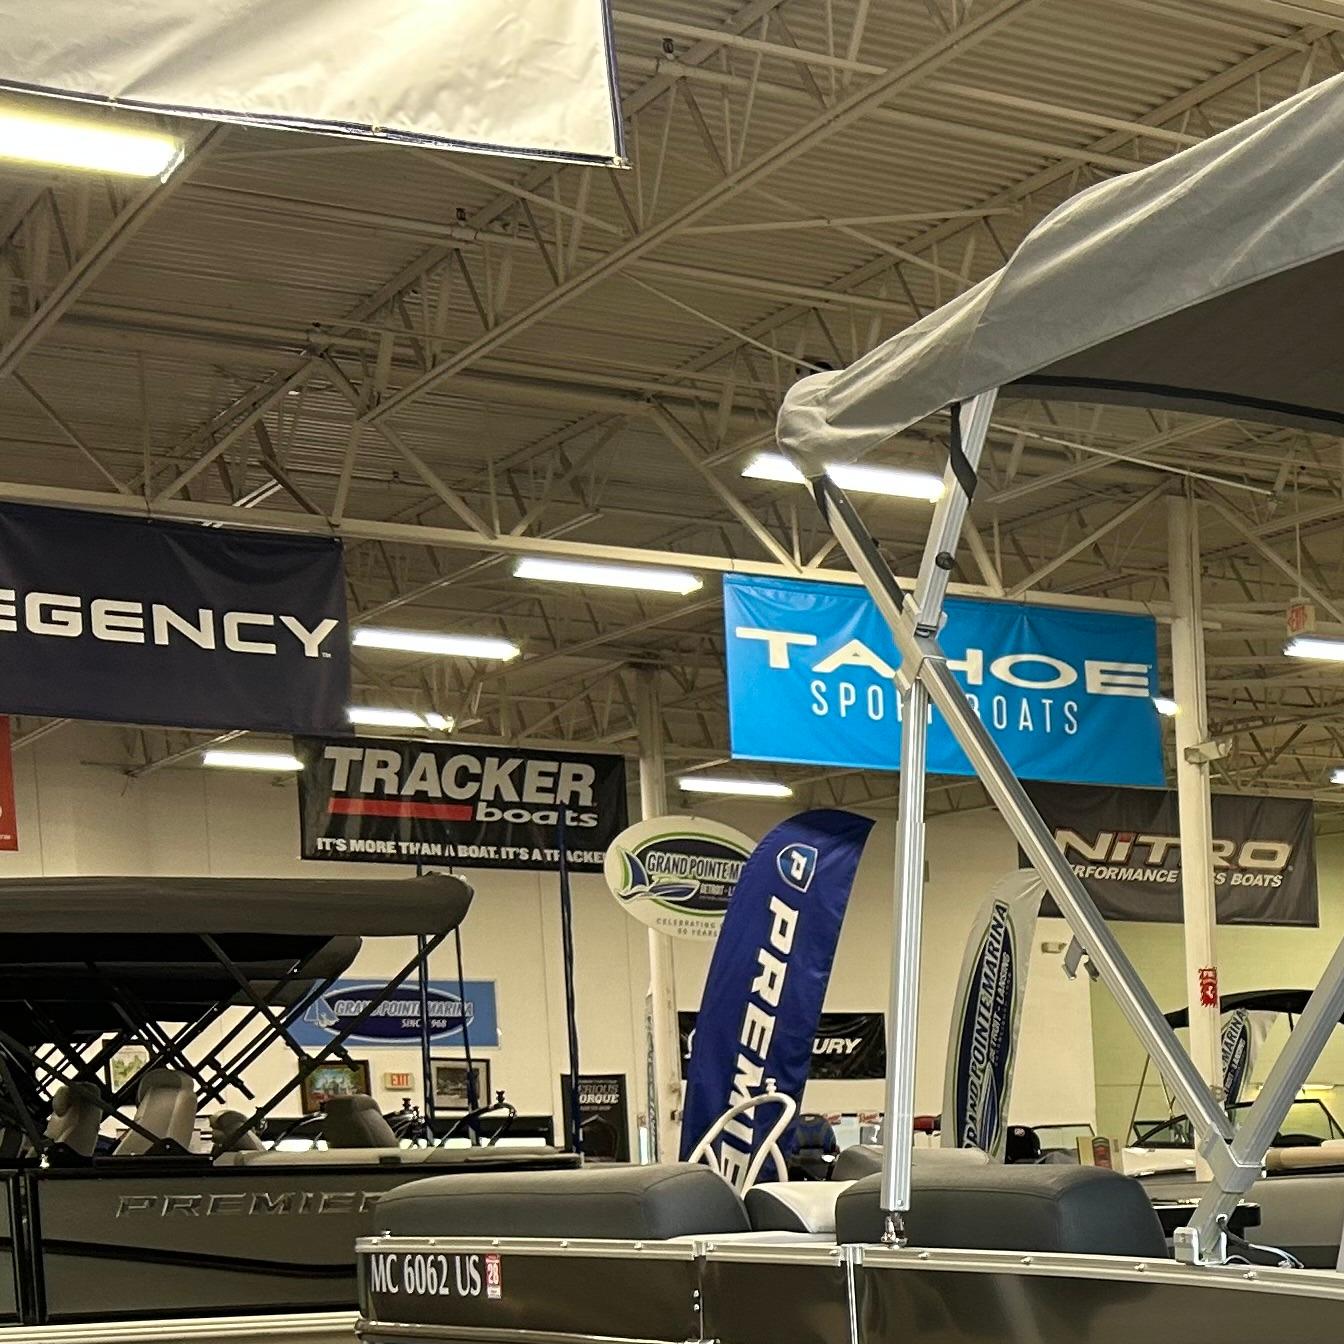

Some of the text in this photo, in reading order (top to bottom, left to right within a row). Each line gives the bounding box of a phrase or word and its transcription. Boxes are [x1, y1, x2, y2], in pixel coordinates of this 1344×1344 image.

[0, 589, 340, 658] GENCY
[735, 626, 1152, 697] TAHOE
[811, 679, 934, 725] SPO
[323, 745, 597, 807] TRACKER
[475, 801, 599, 828] boats
[316, 837, 348, 853] IT'S
[349, 839, 397, 855] MORE
[399, 842, 442, 857] THAN
[457, 844, 499, 861] BOAT.
[501, 846, 529, 861] IT'S
[532, 848, 546, 862] A
[647, 853, 688, 876] GRAND
[689, 858, 727, 879] POINTE
[1069, 864, 1179, 884] RFORMANCE
[1231, 873, 1284, 888] BOATS
[969, 993, 991, 1081] POINTE
[982, 902, 1008, 997] MARINA
[401, 1018, 447, 1029] SINC 968
[720, 895, 800, 1198] PREMIE
[812, 1038, 862, 1054] URY
[579, 1093, 620, 1104] ORQUE
[115, 1191, 390, 1219] PREMIE
[370, 1253, 481, 1297] MC 6062 US
